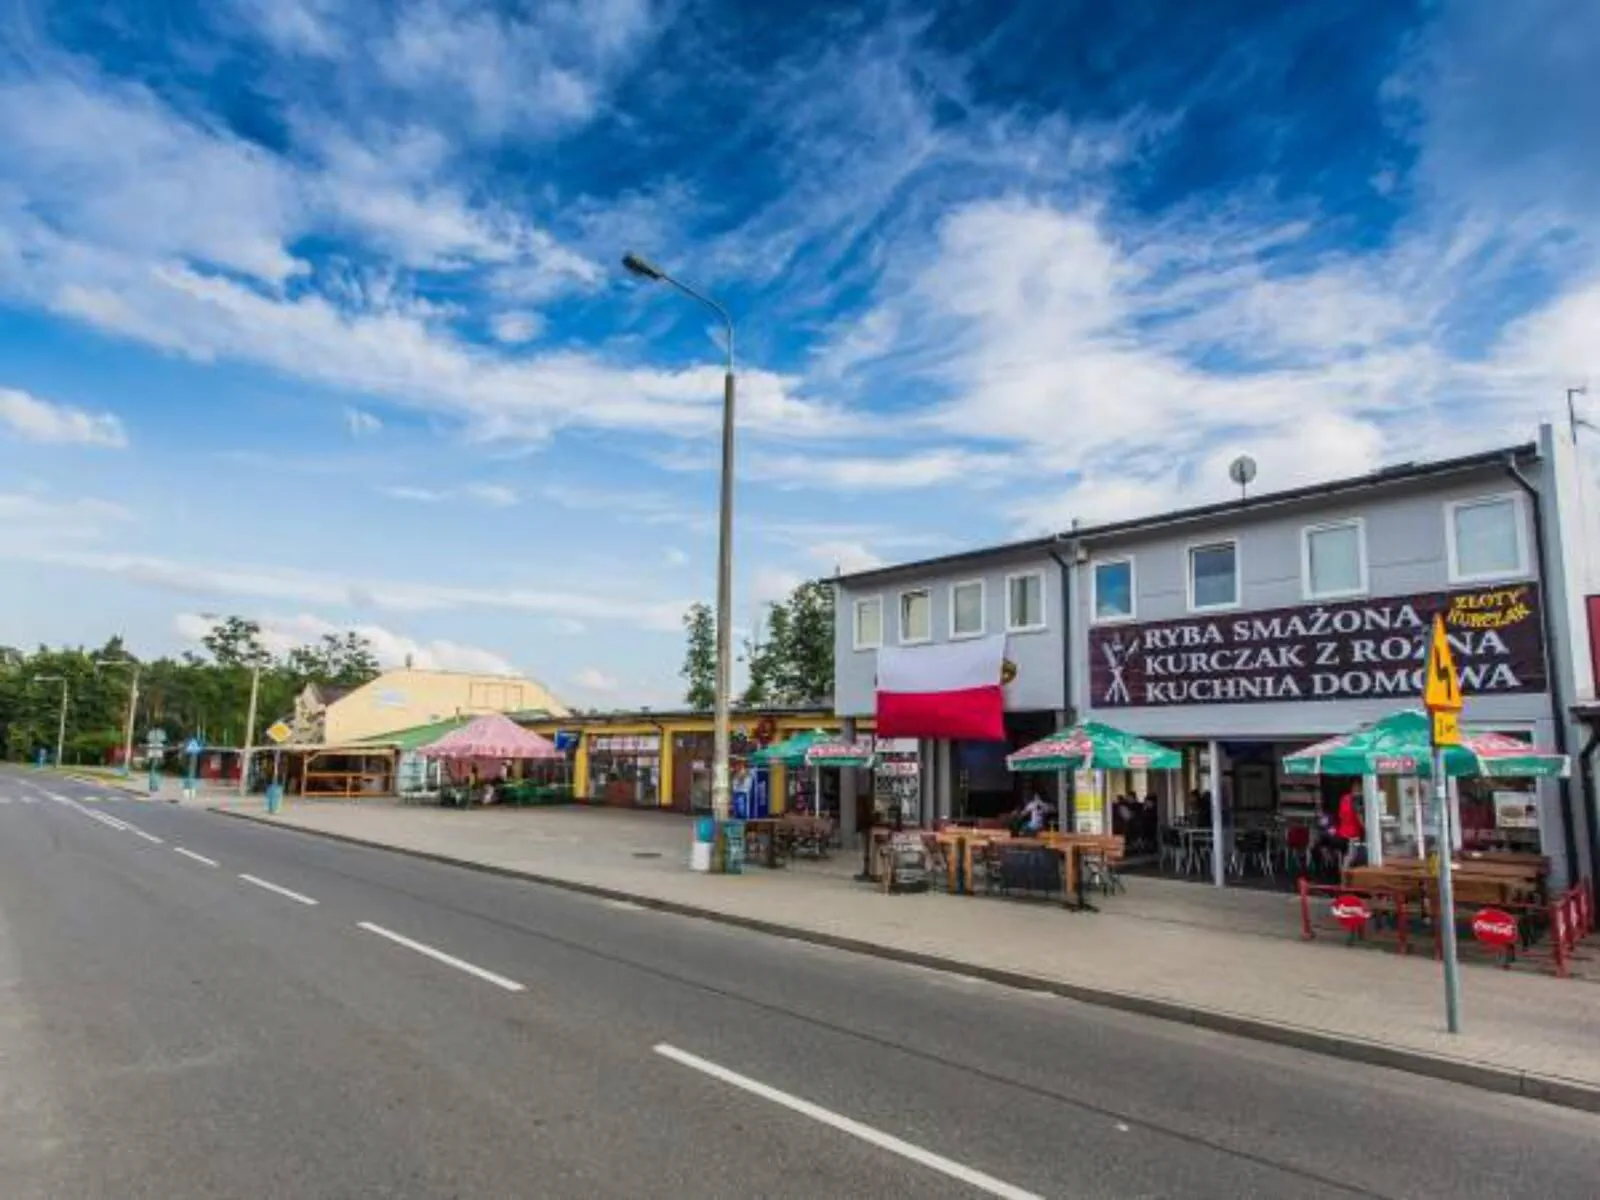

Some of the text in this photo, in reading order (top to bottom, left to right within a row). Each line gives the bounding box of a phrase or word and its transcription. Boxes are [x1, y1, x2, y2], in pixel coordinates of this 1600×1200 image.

[1144, 604, 1422, 649] RYBA SMAŻONA
[1144, 645, 1306, 675] KURCZAK
[1315, 642, 1340, 665] Z
[1145, 674, 1301, 702] KUCHNIA
